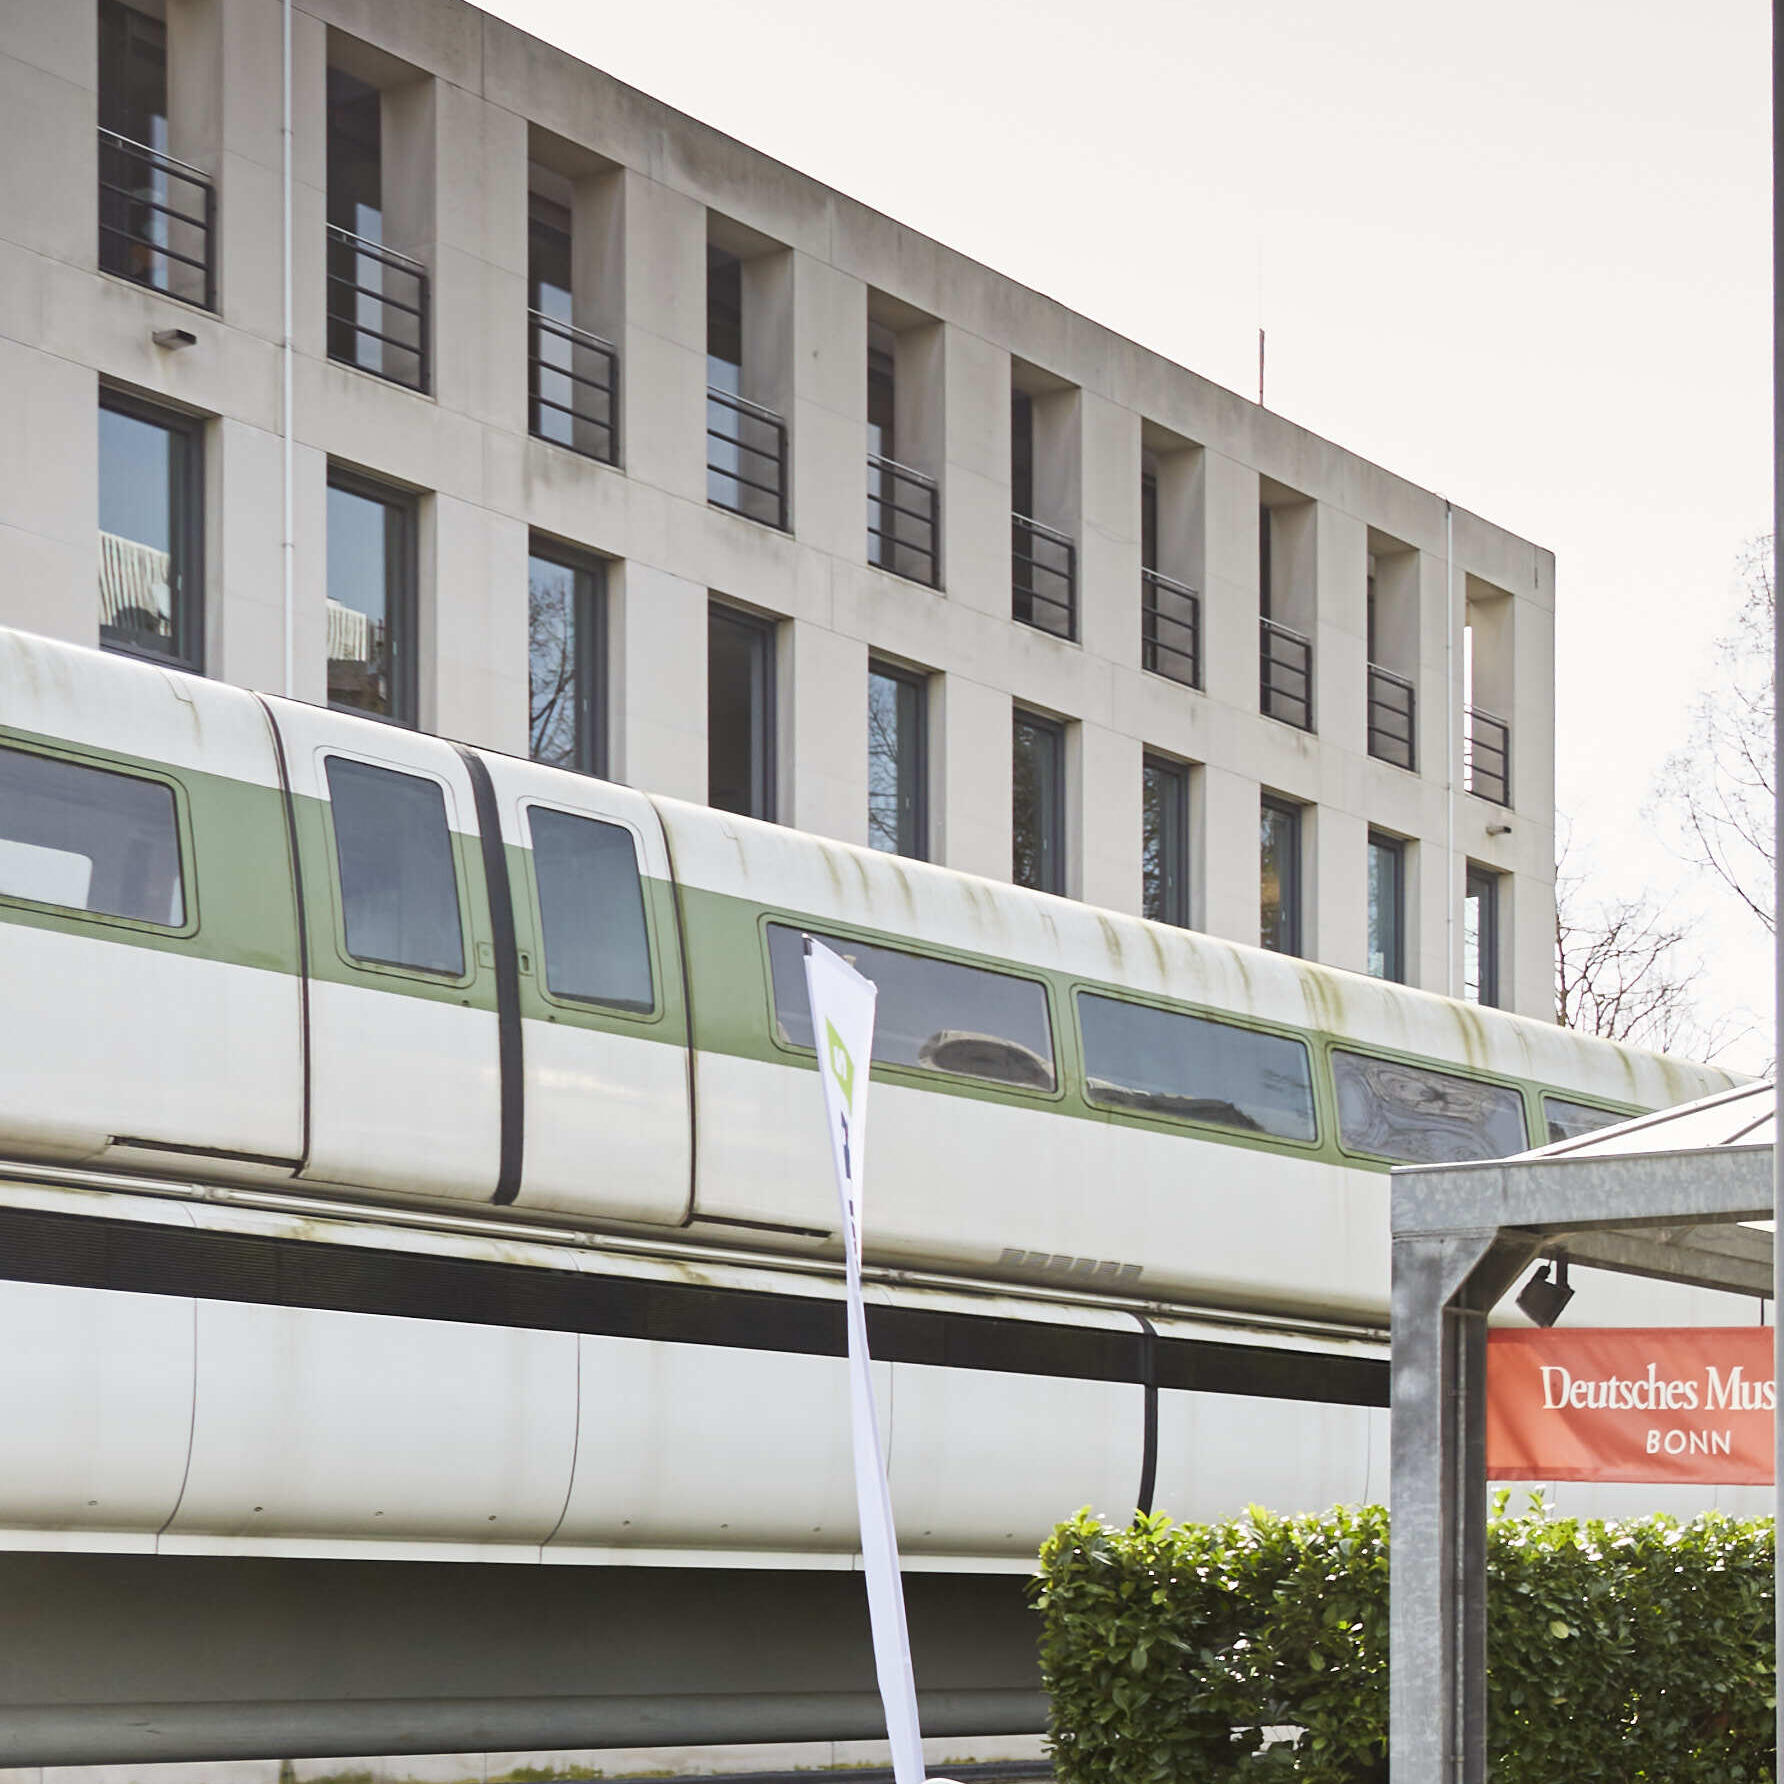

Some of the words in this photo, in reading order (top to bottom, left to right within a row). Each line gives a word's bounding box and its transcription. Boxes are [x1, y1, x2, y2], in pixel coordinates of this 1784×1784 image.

[1539, 1362, 1699, 1411] Deutsches
[1703, 1365, 1775, 1411] Mus
[1645, 1429, 1732, 1456] BONN
